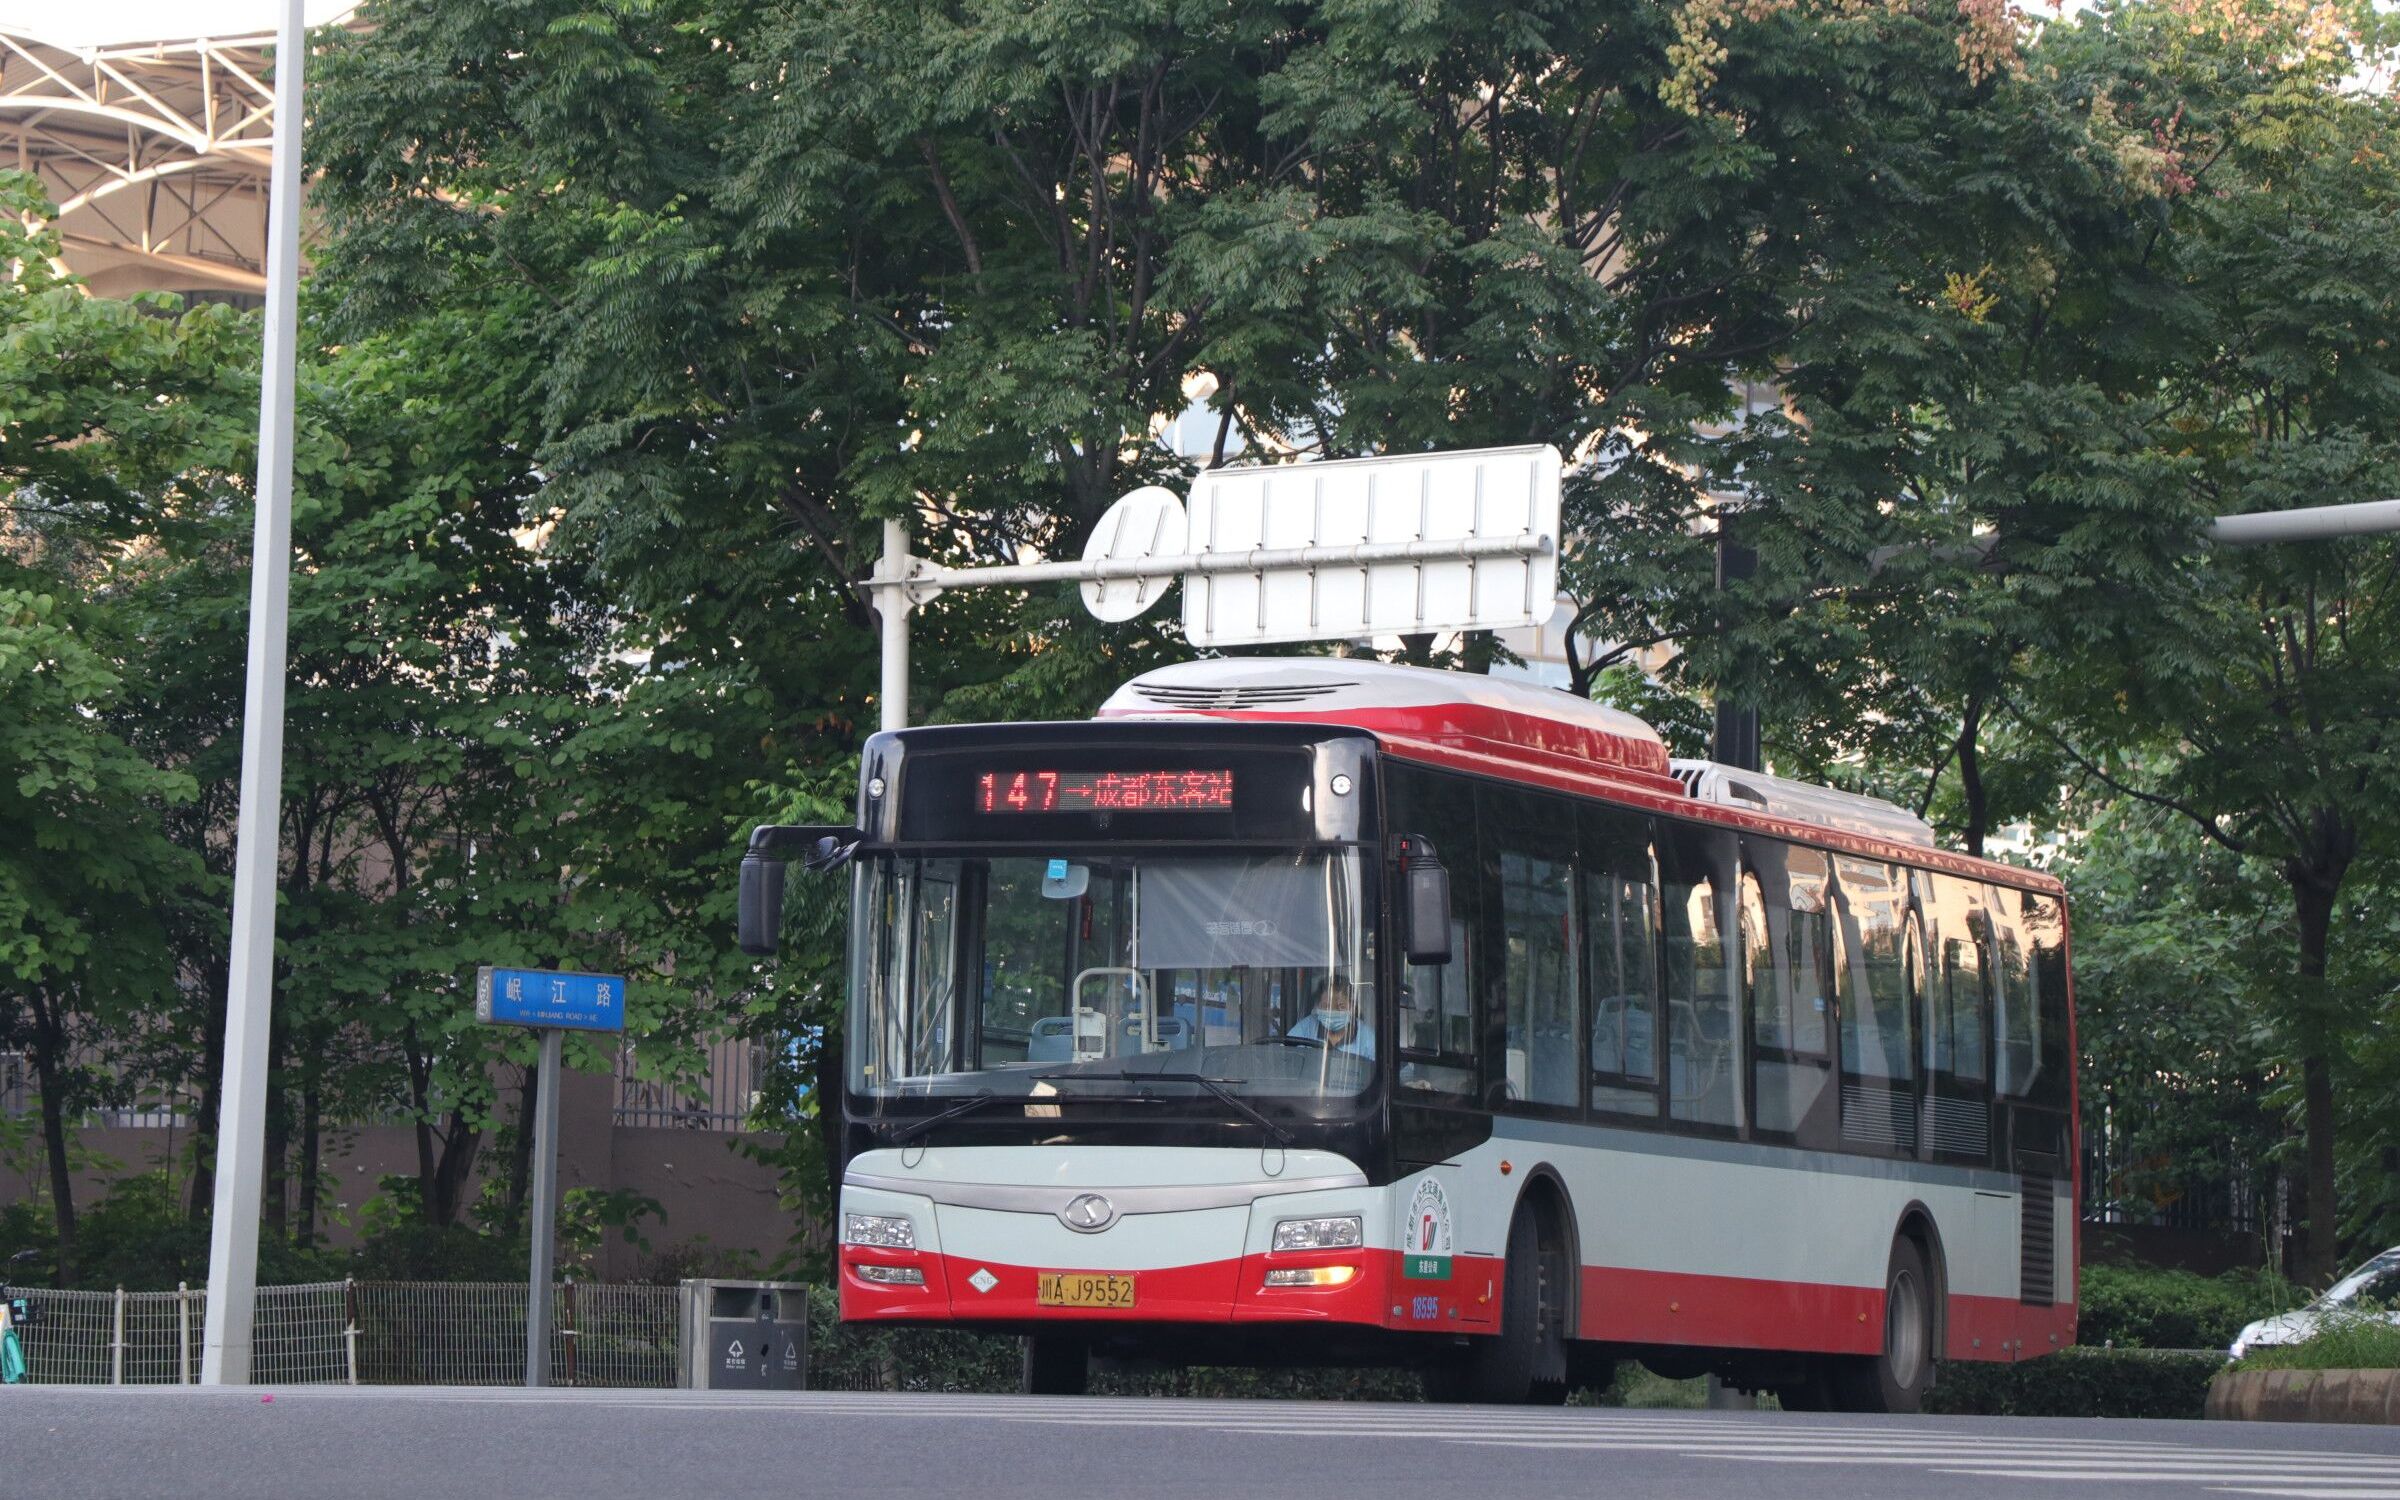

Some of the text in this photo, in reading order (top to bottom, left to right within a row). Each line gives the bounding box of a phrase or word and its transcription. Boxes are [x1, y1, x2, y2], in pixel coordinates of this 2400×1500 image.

[981, 770, 1232, 811] 147 成都东客站
[506, 977, 612, 1008] 岷江路
[973, 1275, 993, 1285] CNG
[1412, 1296, 1438, 1319] 18595
